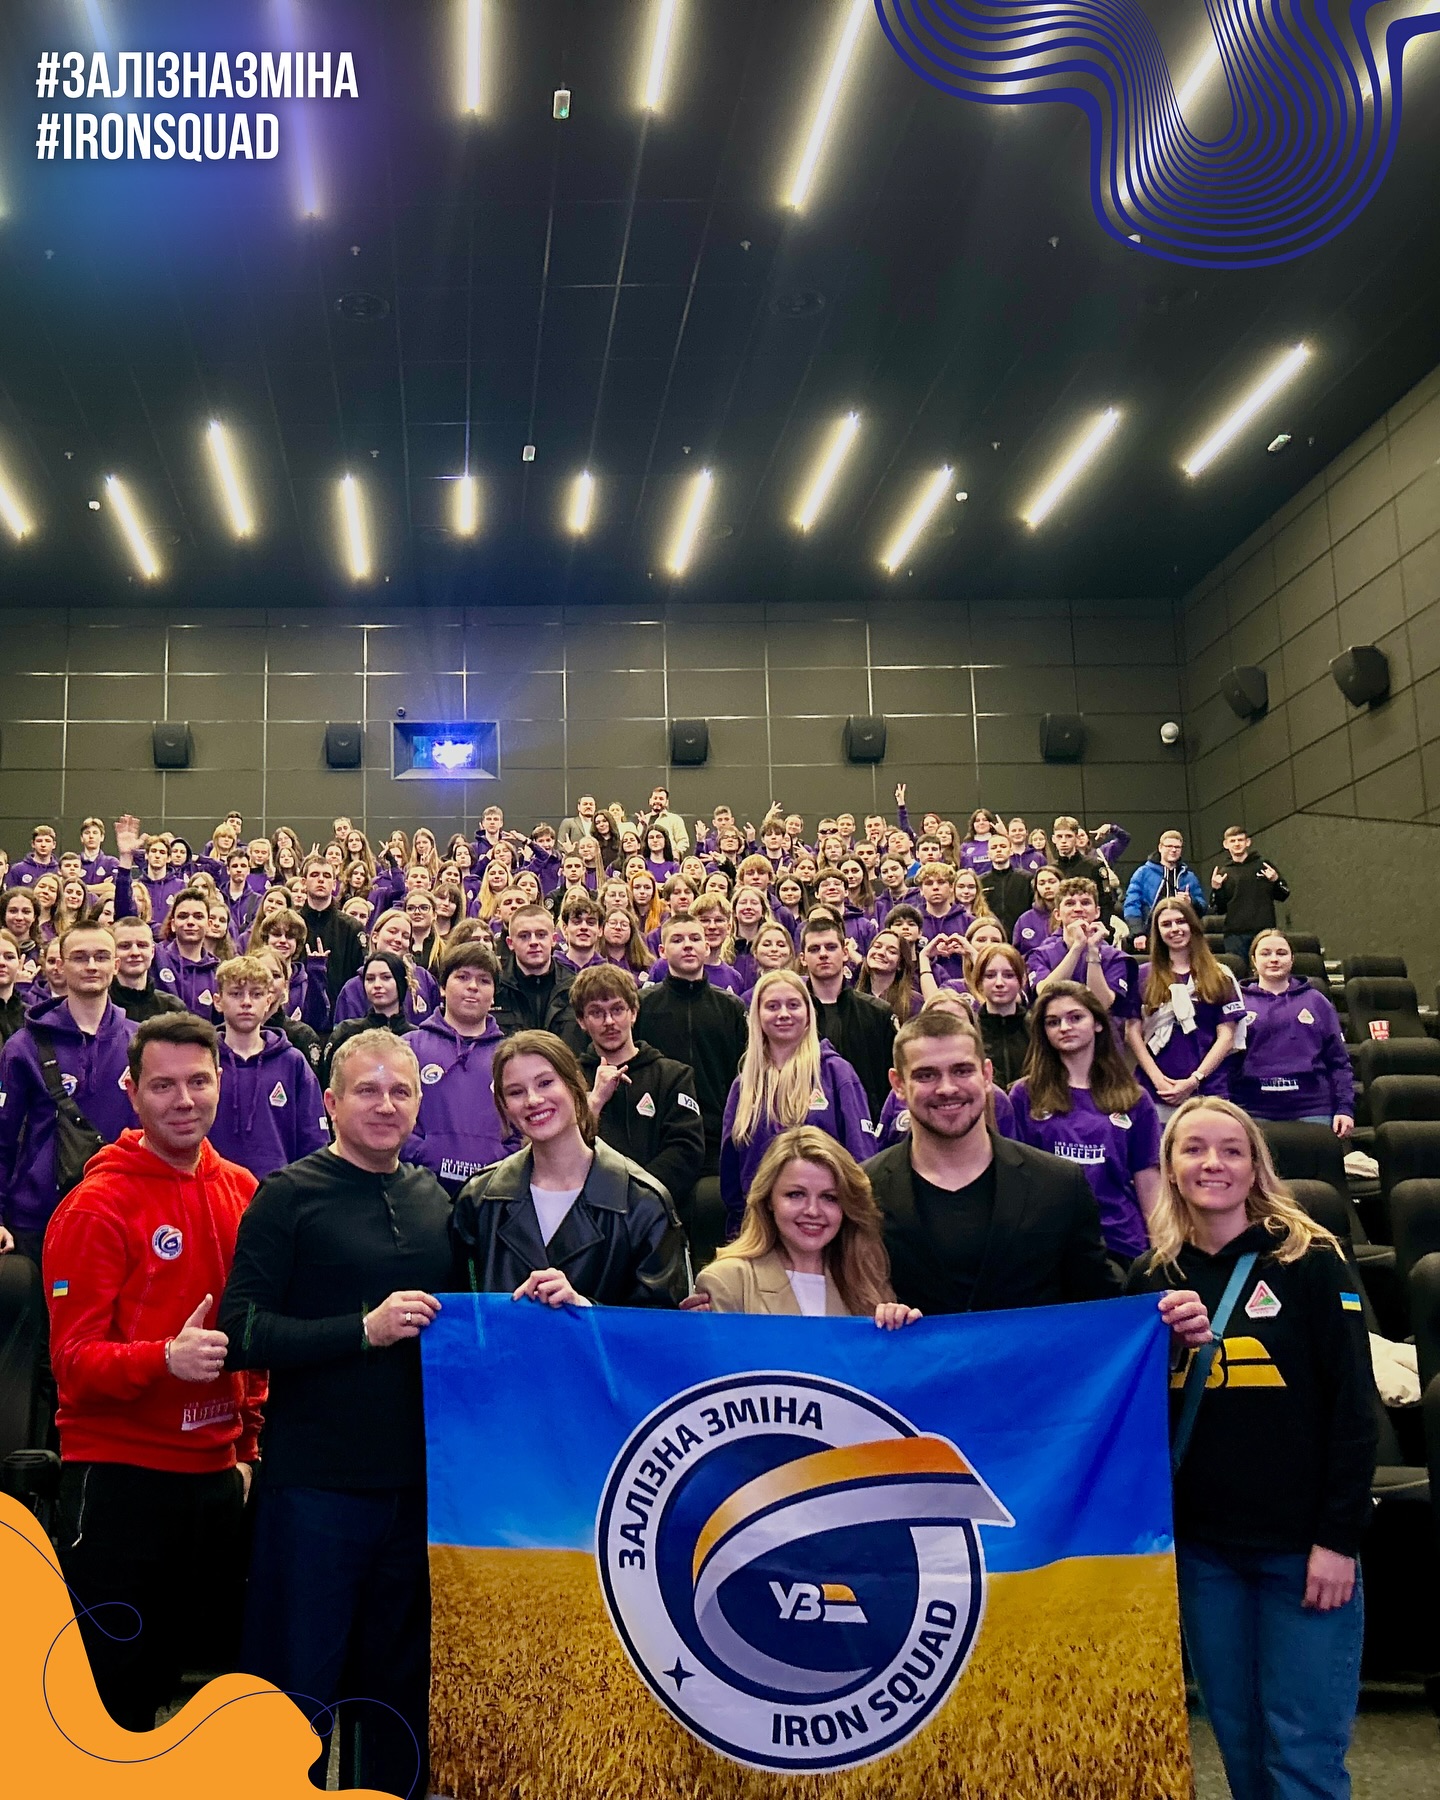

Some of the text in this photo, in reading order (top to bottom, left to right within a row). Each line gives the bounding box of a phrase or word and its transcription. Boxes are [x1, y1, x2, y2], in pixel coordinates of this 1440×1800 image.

[1054, 1146, 1106, 1159] BUFFETT
[619, 1396, 823, 1570] ЗАЛІЗНА ЗМІНА
[771, 1599, 957, 1746] IRON SQUAD
